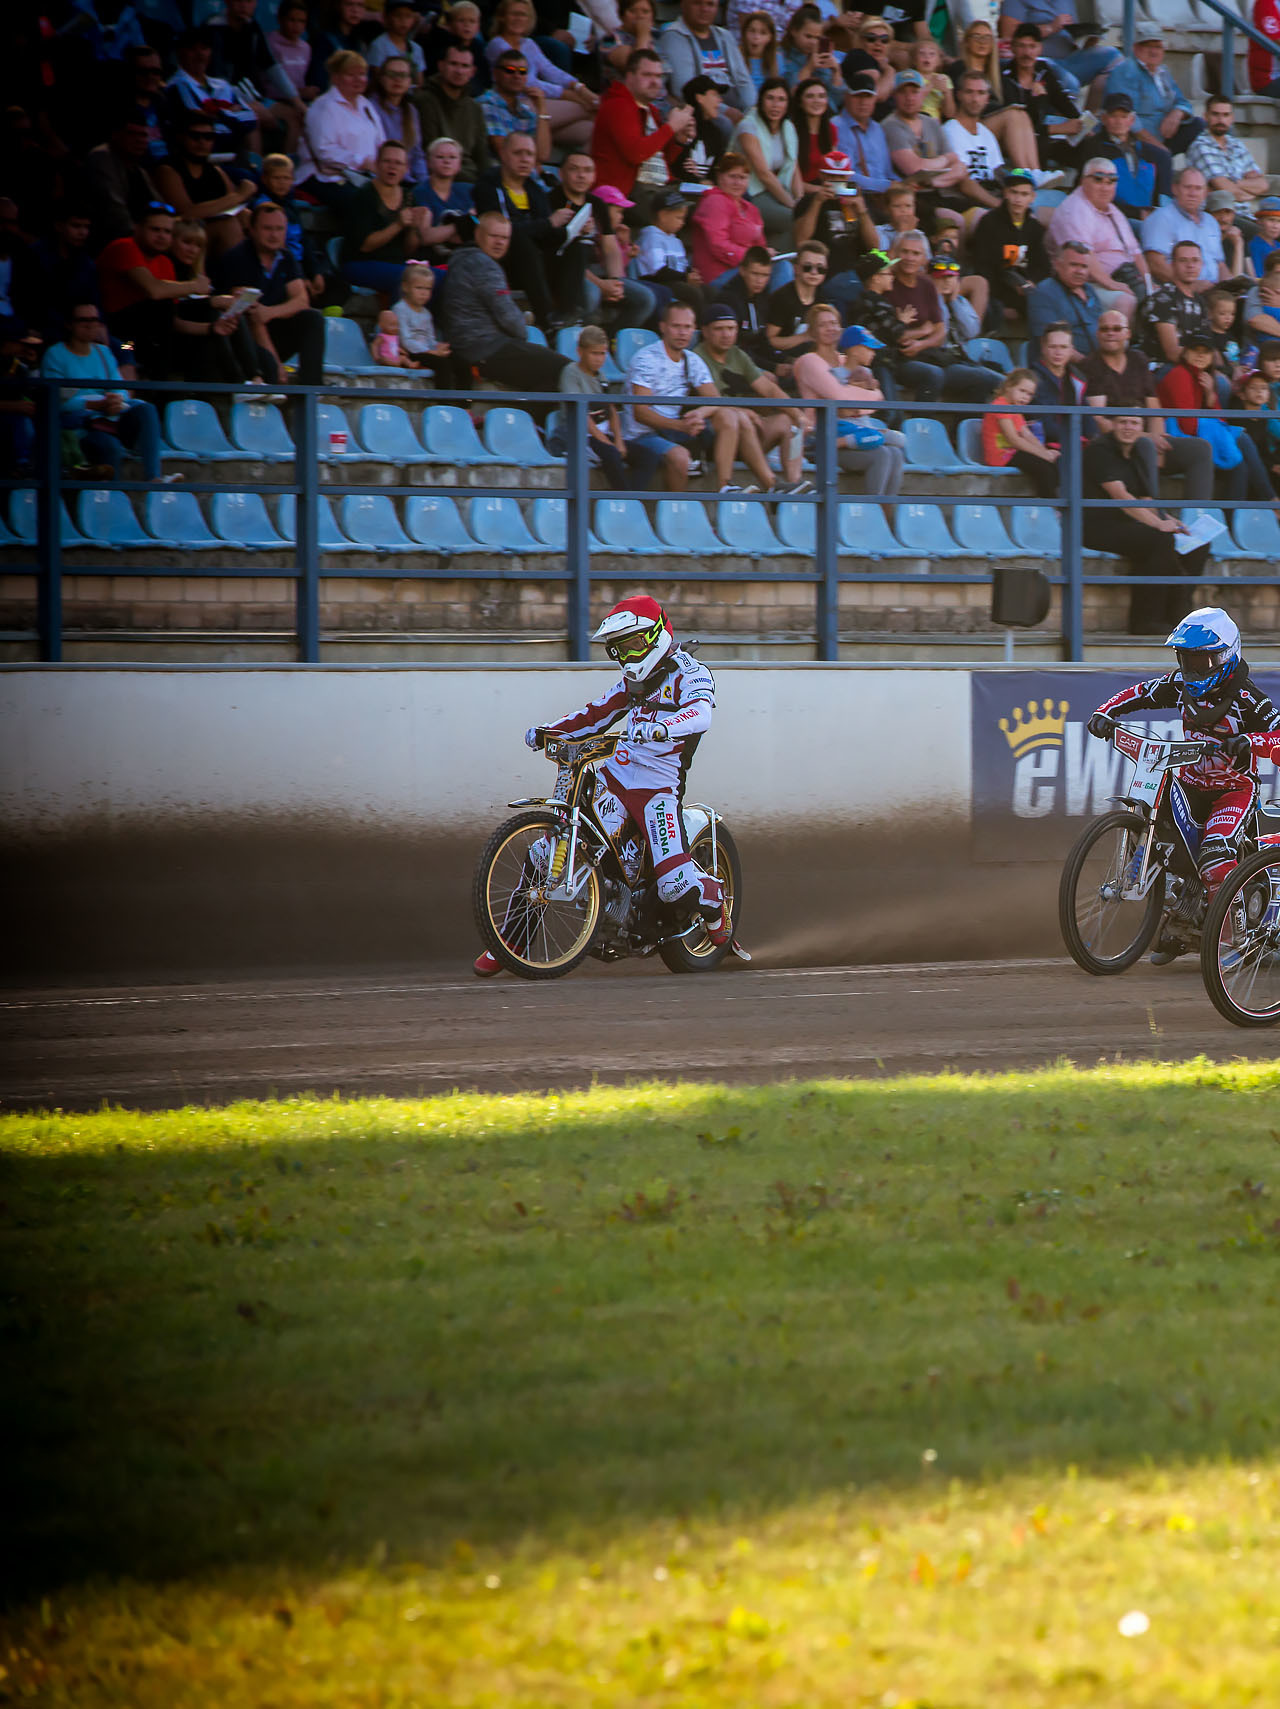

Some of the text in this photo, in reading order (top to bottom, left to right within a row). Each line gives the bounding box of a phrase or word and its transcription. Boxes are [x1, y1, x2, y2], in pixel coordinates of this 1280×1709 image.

[652, 800, 670, 857] VERONA
[665, 813, 676, 839] BAR
[1212, 815, 1235, 824] HAWA
